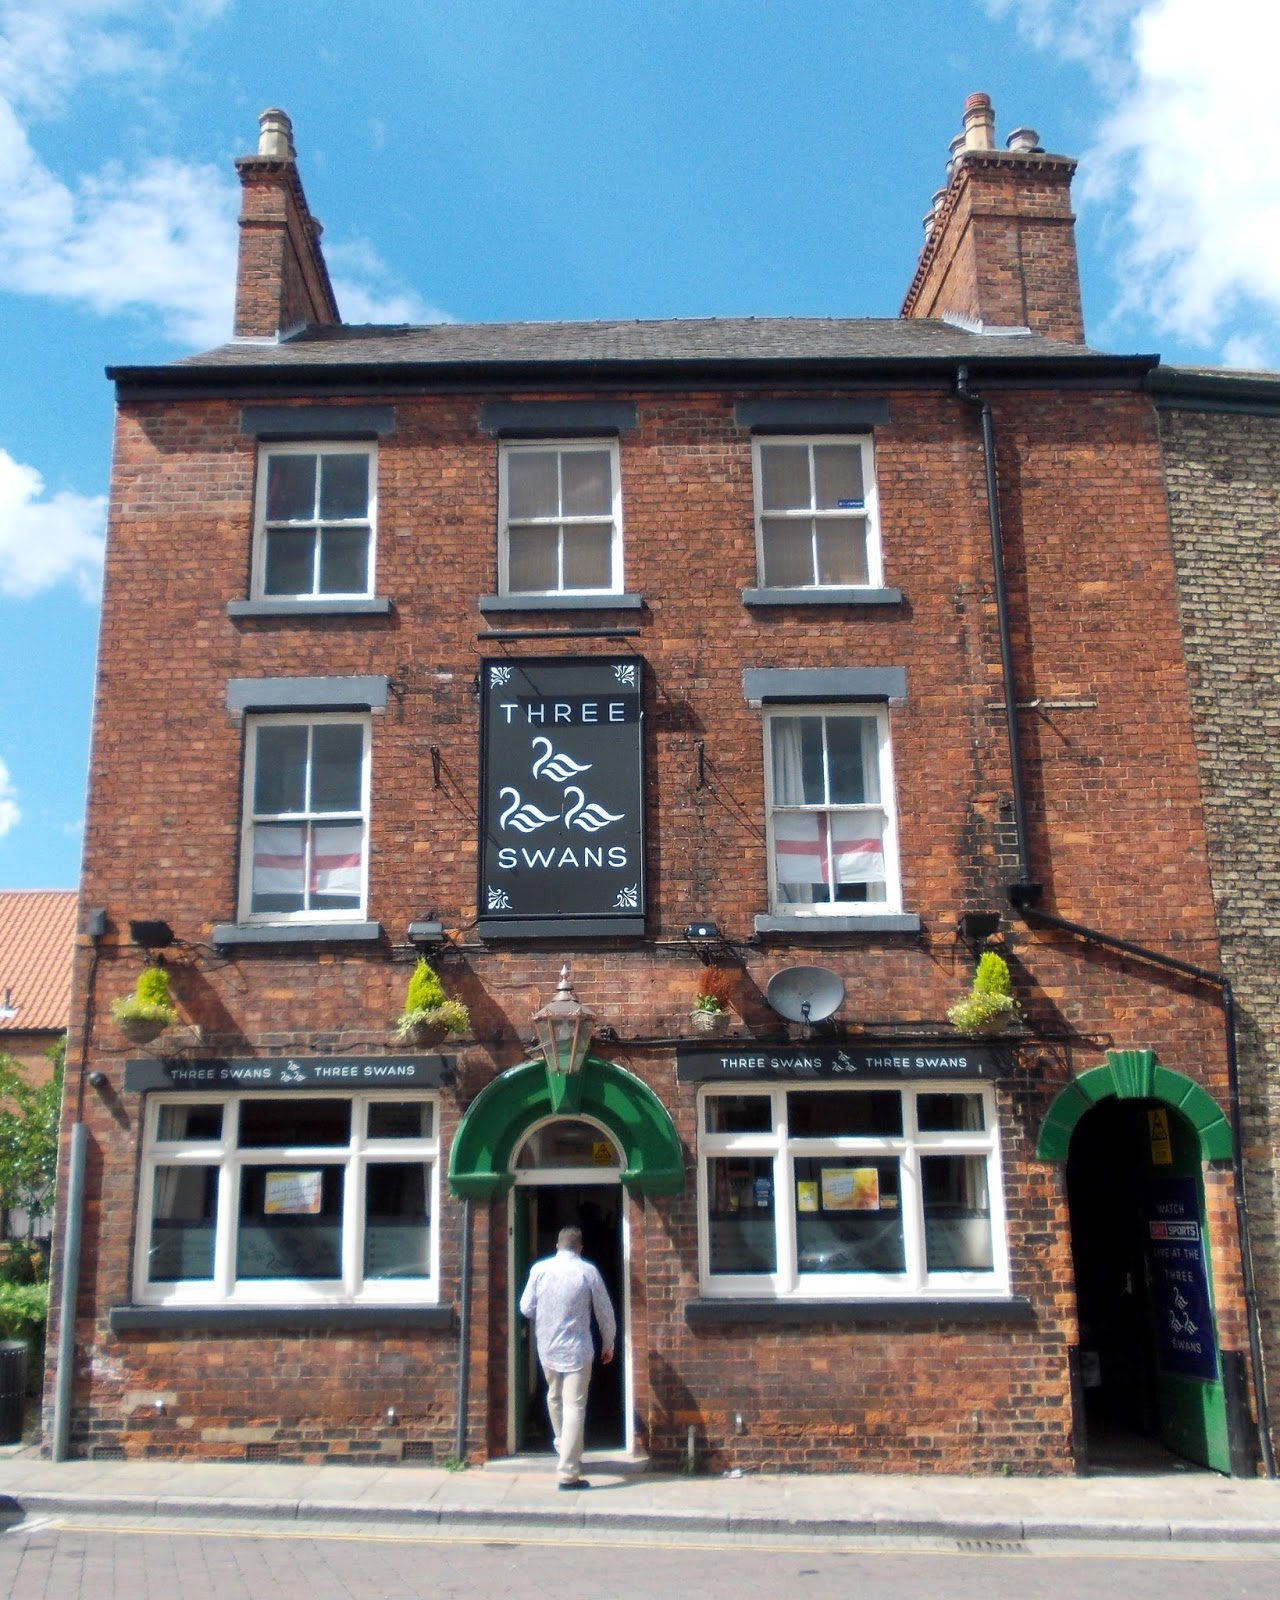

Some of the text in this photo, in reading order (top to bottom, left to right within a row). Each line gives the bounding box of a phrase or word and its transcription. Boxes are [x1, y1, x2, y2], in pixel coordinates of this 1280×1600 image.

[500, 702, 625, 724] THREE
[498, 846, 627, 869] SWANS
[721, 1058, 822, 1068] THREE SWANS
[865, 1057, 967, 1068] THREE SWANS
[170, 1068, 271, 1079] THREE SWANS
[314, 1065, 415, 1077] THREE SWANS
[1156, 1203, 1184, 1214] WATCH
[1168, 1225, 1196, 1237] SPORTS
[1172, 1248, 1181, 1258] AT
[1184, 1249, 1199, 1260] THE
[1164, 1268, 1194, 1283] THREE
[1171, 1337, 1202, 1354] SWANS
